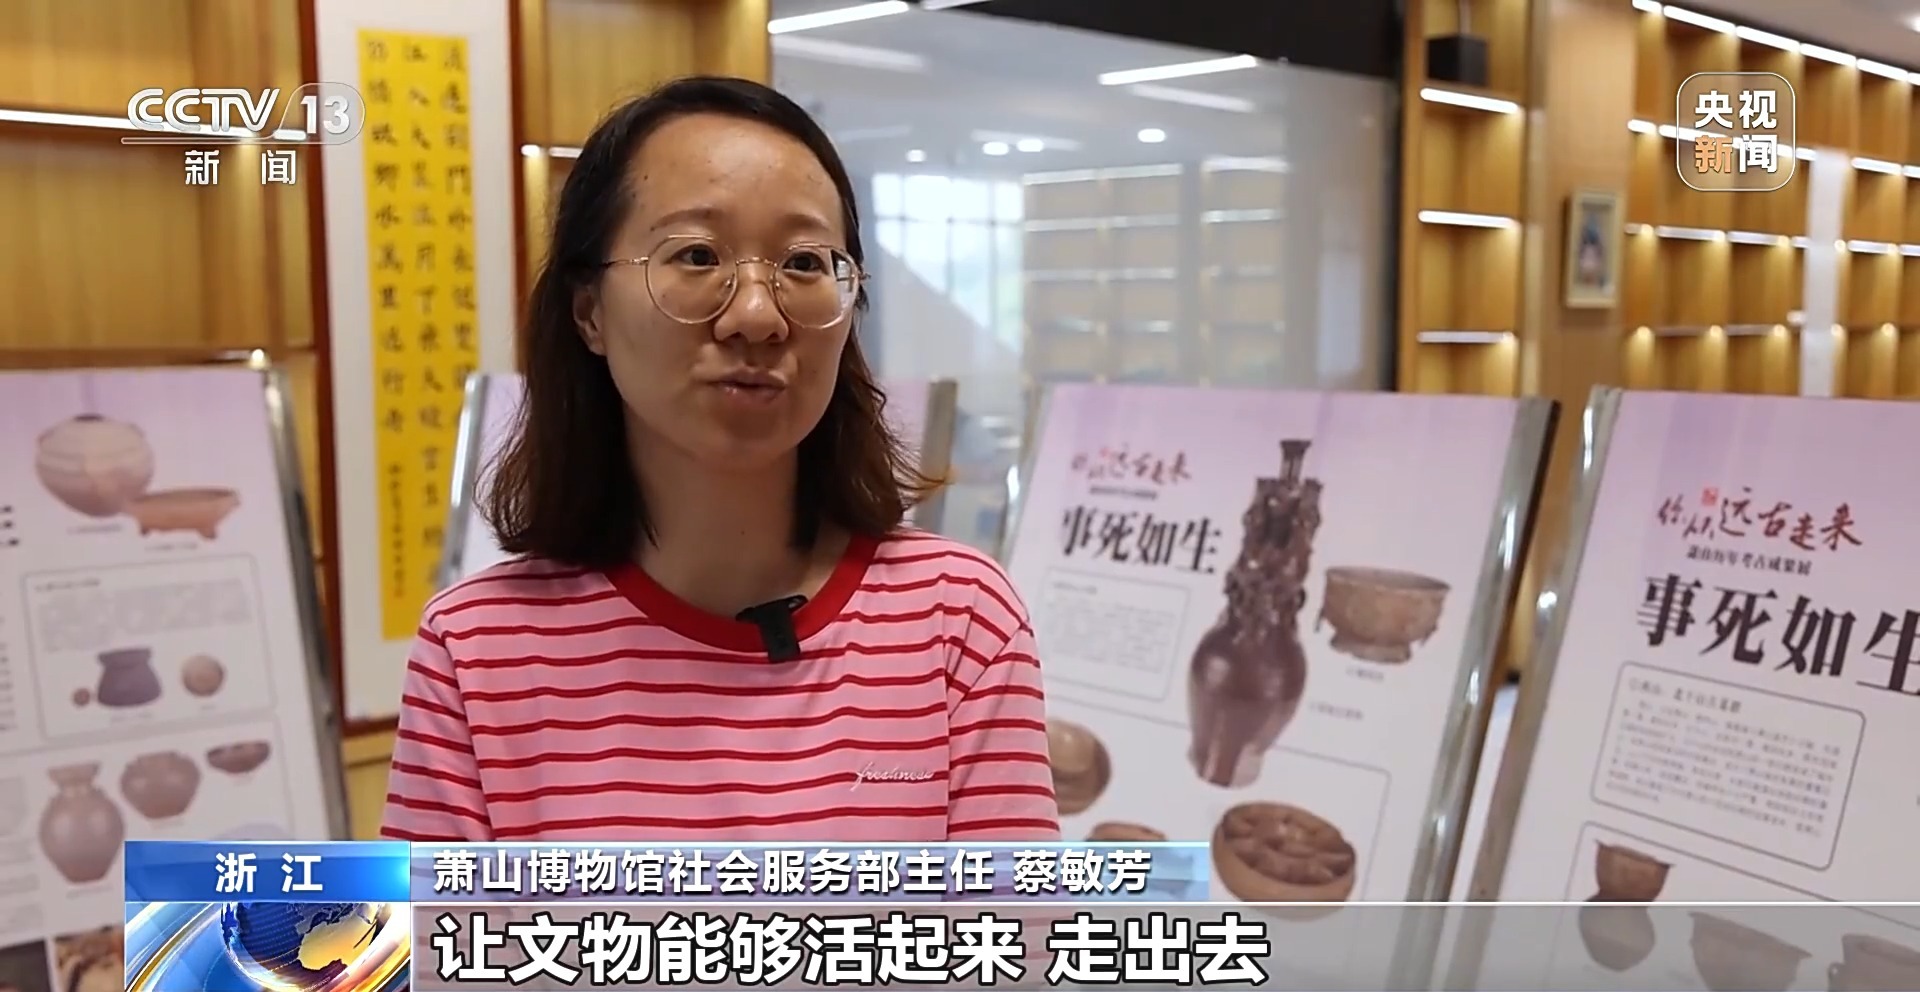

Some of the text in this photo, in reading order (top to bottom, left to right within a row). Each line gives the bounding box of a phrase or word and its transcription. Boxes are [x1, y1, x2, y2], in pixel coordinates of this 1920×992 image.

[1060, 504, 1223, 574] 事死如生
[1636, 573, 1920, 696] 事死如生
